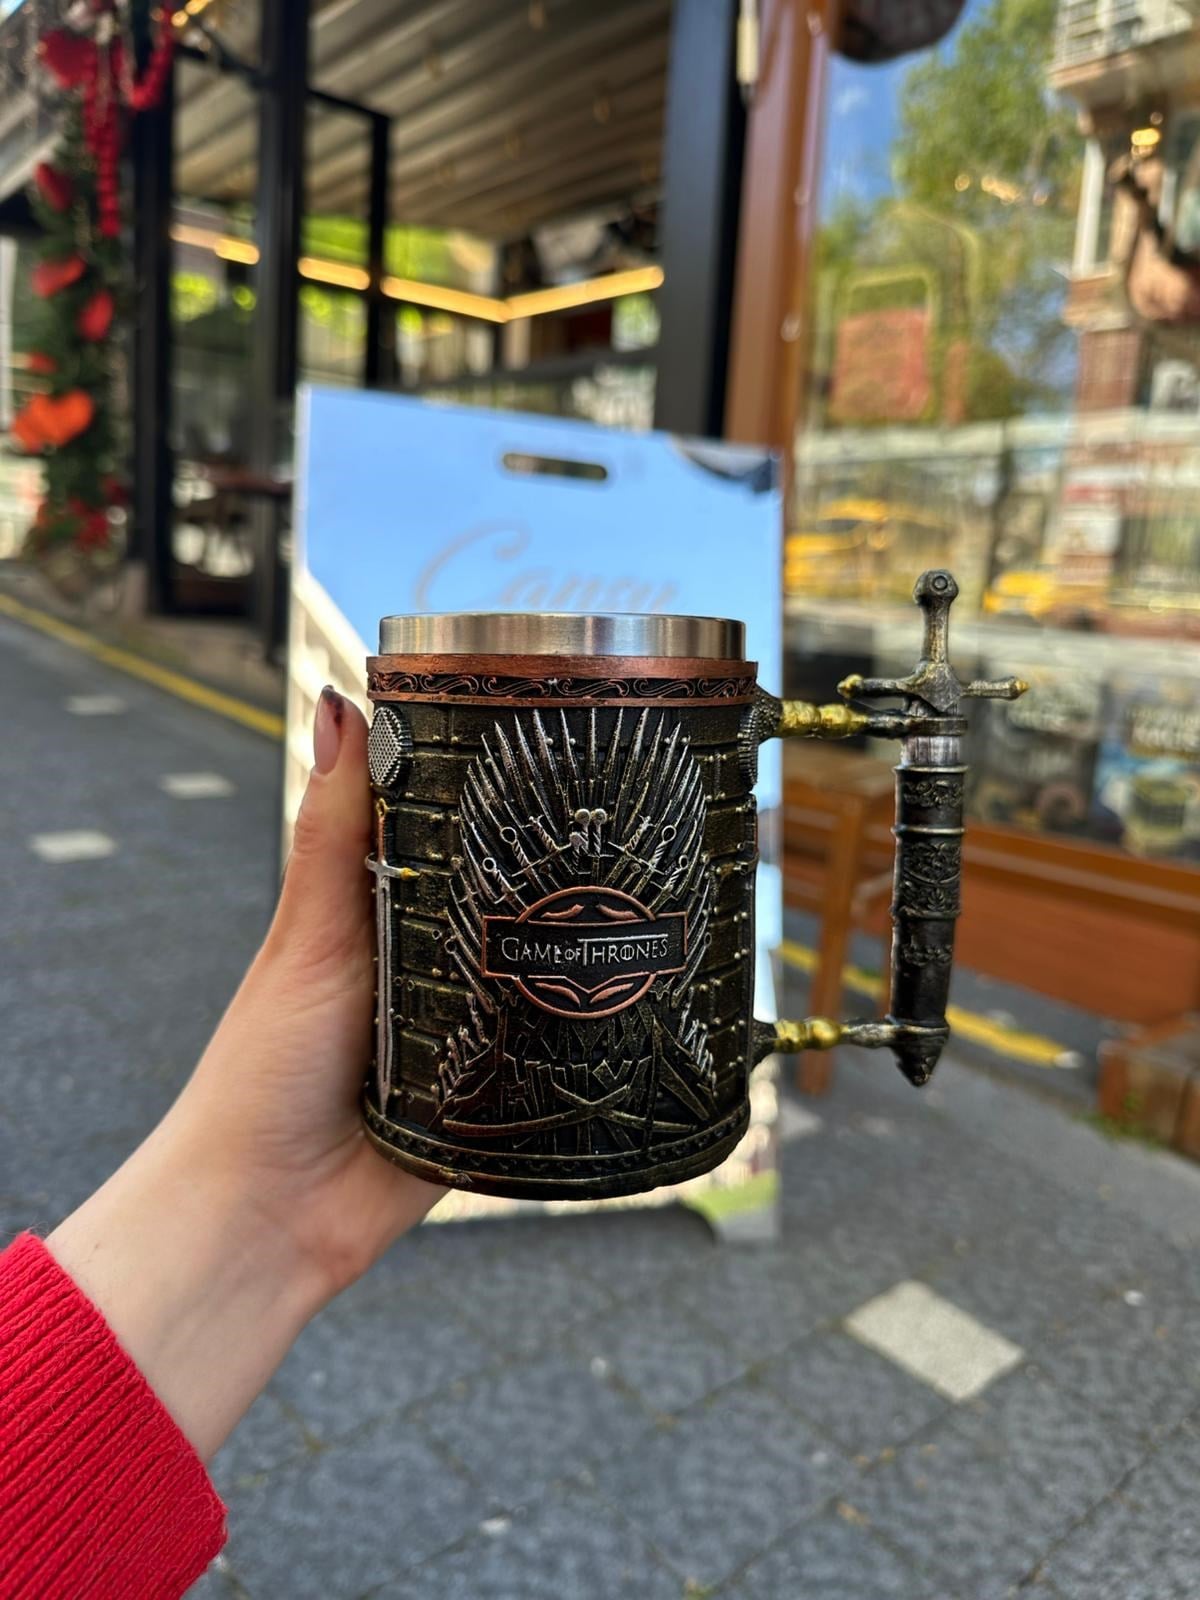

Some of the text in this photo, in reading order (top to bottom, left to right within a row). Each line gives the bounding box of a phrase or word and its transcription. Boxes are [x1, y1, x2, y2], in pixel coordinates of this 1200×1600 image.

[501, 933, 669, 966] GAME OF THRONES
